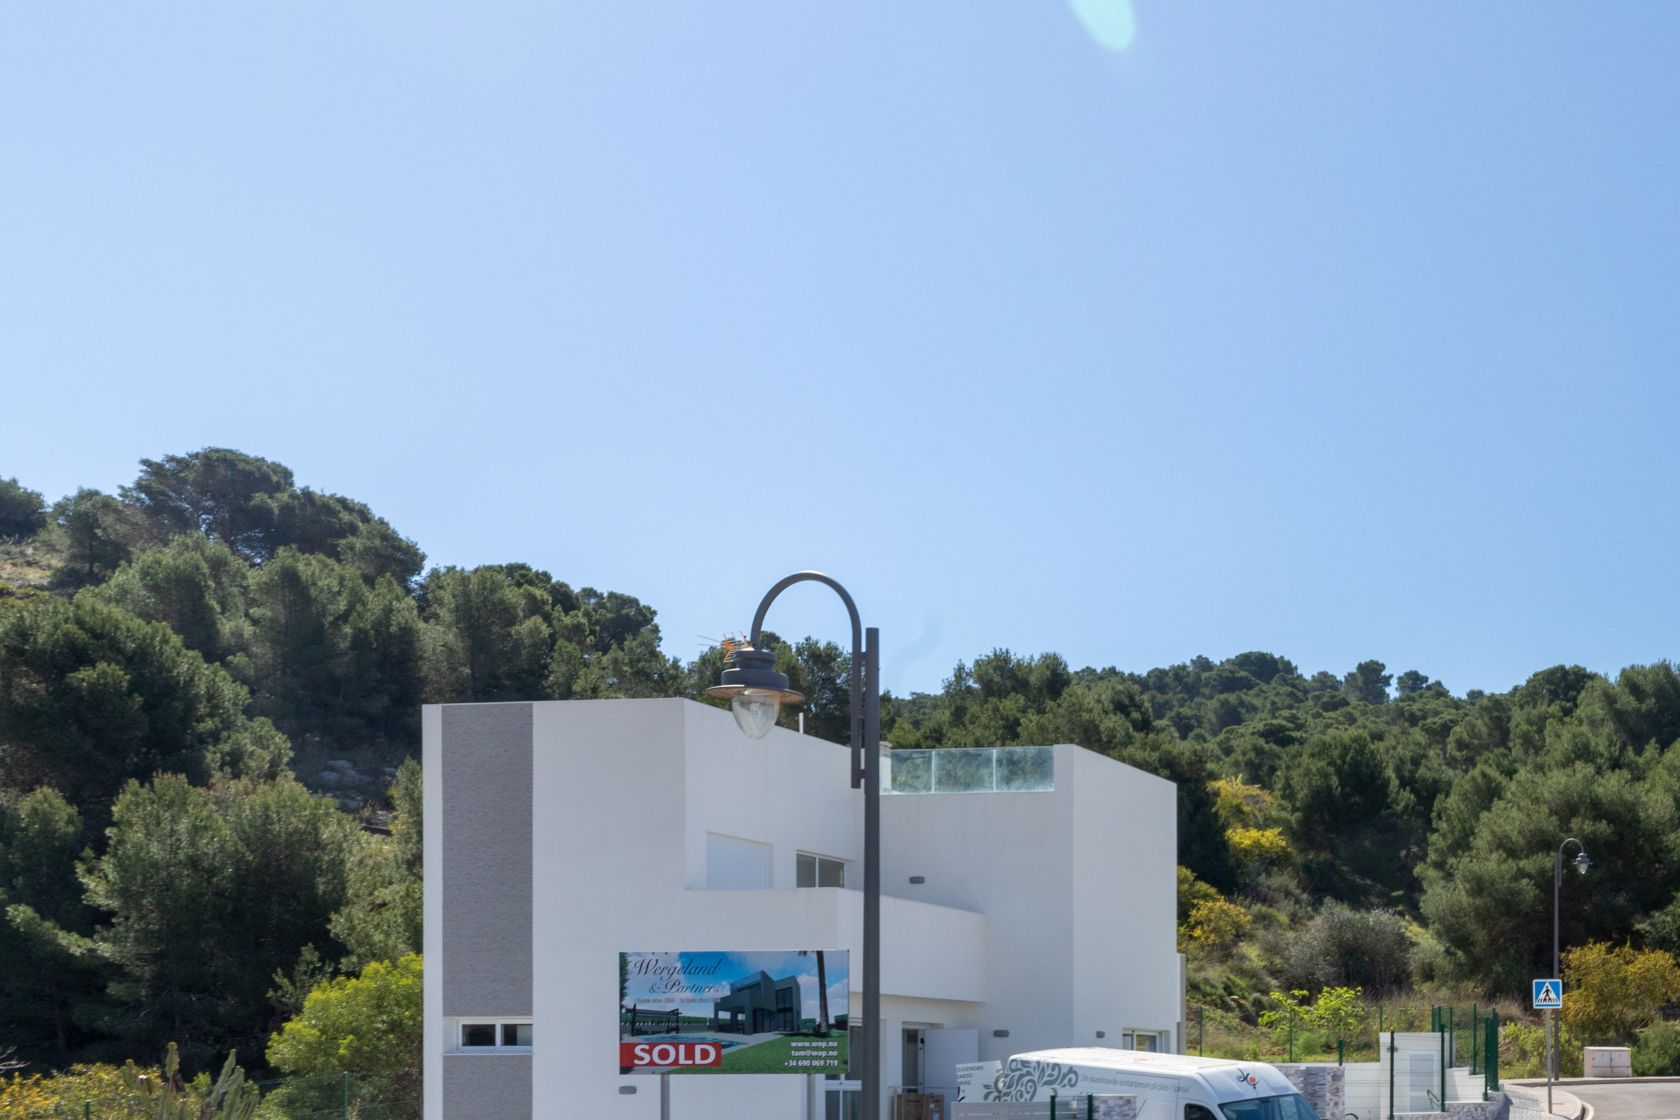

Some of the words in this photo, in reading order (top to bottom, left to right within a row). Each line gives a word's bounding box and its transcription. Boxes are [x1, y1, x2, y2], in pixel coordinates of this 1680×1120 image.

[634, 957, 722, 982] Wergeland
[649, 982, 661, 993] &
[662, 979, 719, 994] Partners
[633, 1044, 716, 1065] SOLD
